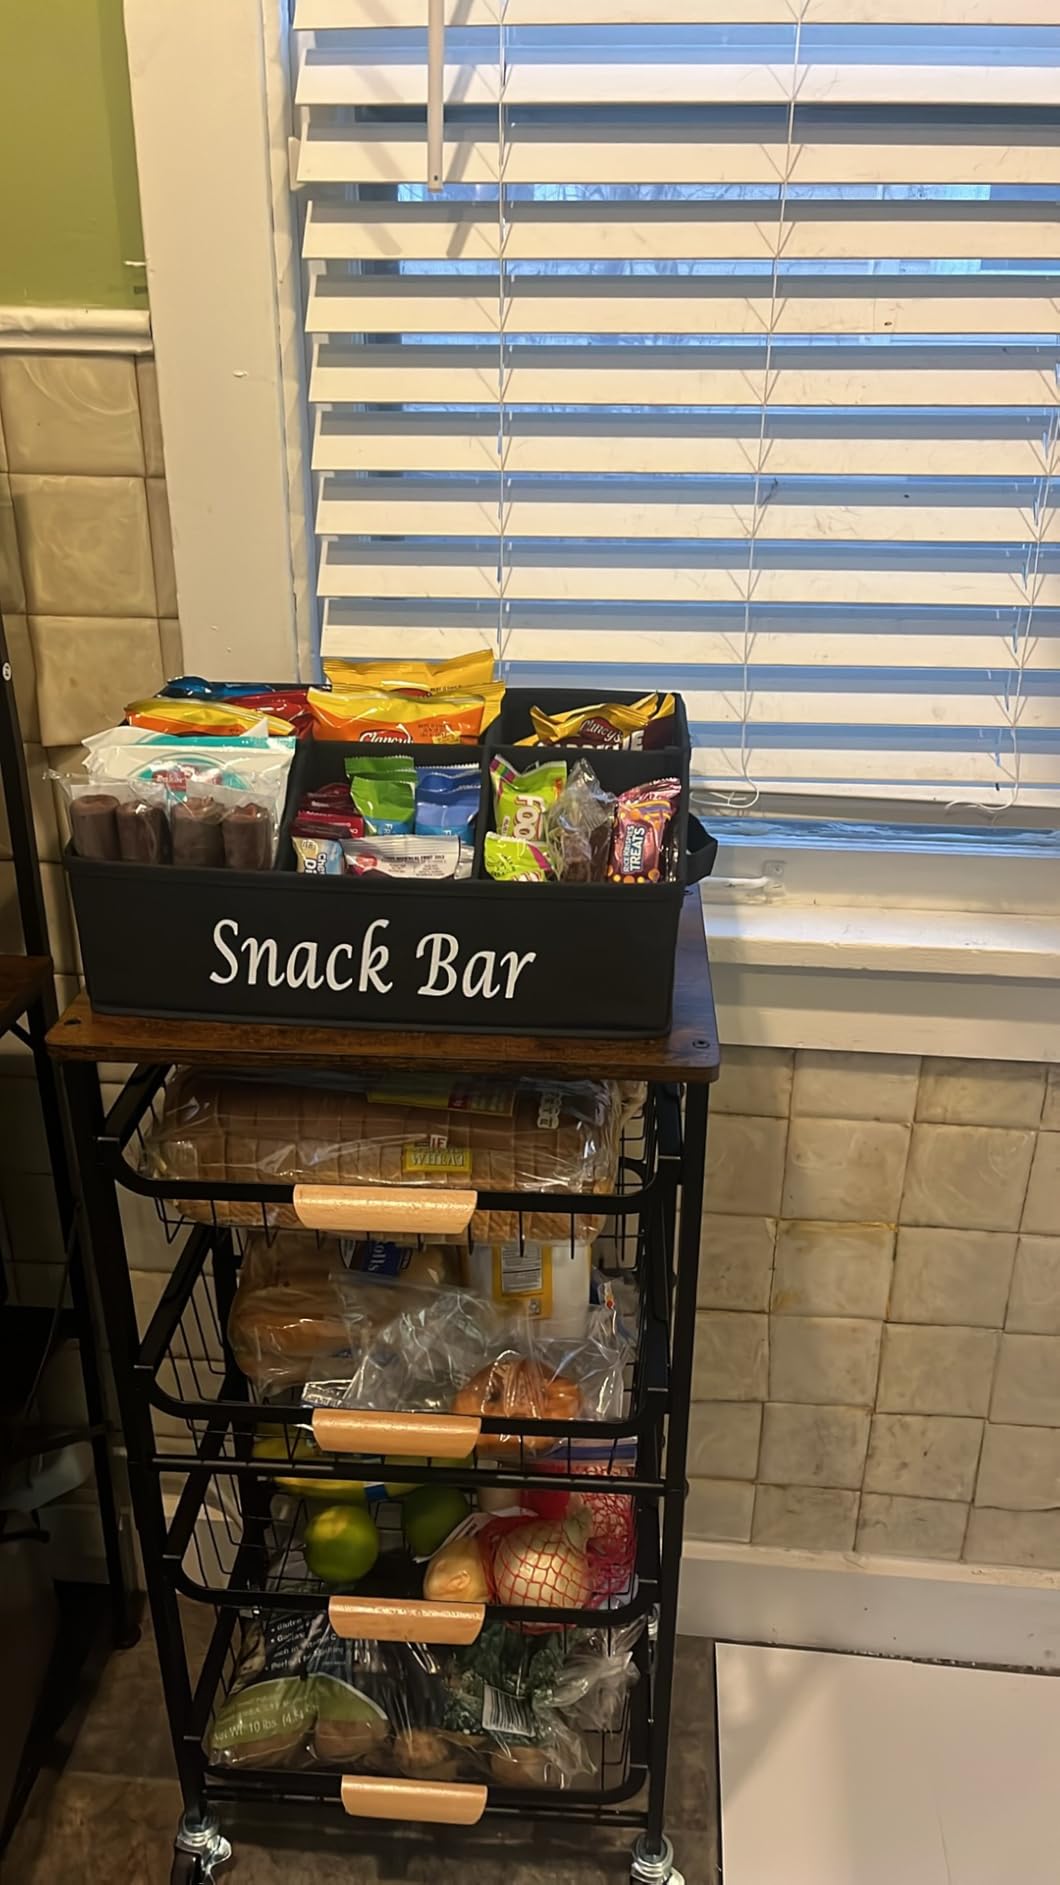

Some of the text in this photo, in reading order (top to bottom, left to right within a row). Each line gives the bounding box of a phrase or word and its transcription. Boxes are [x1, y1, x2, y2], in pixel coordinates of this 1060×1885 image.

[630, 827, 645, 871] TREATS
[209, 918, 537, 999] Snack Bar
[249, 1719, 261, 1733] 10
